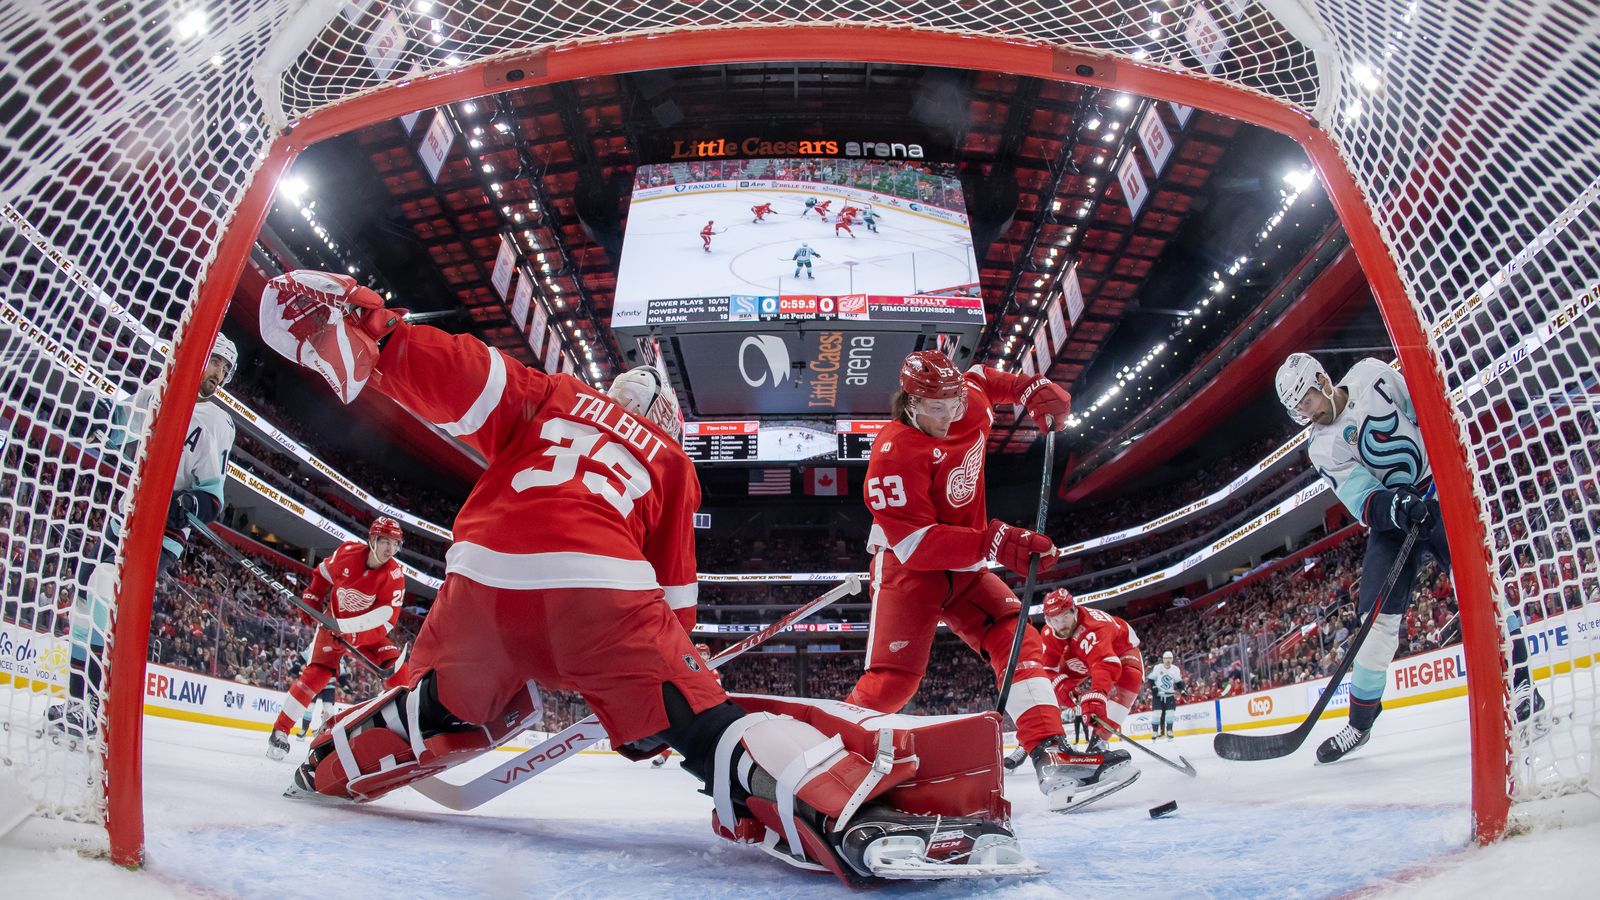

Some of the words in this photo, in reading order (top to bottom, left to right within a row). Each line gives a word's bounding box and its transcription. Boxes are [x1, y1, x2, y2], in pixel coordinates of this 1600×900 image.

[671, 138, 737, 159] Little
[742, 137, 838, 155] Caesars
[845, 141, 924, 158] arena
[688, 182, 727, 190] FANDUEL
[616, 310, 642, 318] xfinity
[762, 298, 777, 312] 0
[780, 300, 816, 309] 0:59.9
[820, 298, 834, 312] 0
[904, 298, 947, 306] PENALTY
[846, 336, 875, 386] arena
[940, 368, 954, 378] 53
[808, 373, 839, 407] Little
[1374, 378, 1393, 404] C
[233, 401, 257, 422] NOTHING!
[184, 426, 202, 453] A
[570, 392, 667, 462] TALBOT
[1259, 432, 1307, 470] PERFORMANCE
[308, 456, 354, 492] PERFORMANCE
[355, 488, 368, 500] TIRE
[510, 417, 652, 520] 39
[248, 476, 279, 500] SACRIFICE
[280, 495, 306, 516] NOTHING!
[867, 475, 907, 510] 53
[1142, 508, 1192, 531] PERFORMANCE
[1194, 499, 1209, 510] TIRE
[1212, 518, 1263, 552] PERFORMANCE
[1264, 507, 1281, 522] TIRE
[241, 558, 295, 599] BAUER
[391, 590, 404, 607] 2
[1080, 632, 1099, 655] 22
[36, 670, 56, 680] VODA
[1251, 696, 1272, 715] hap
[490, 733, 596, 785] VAPOR
